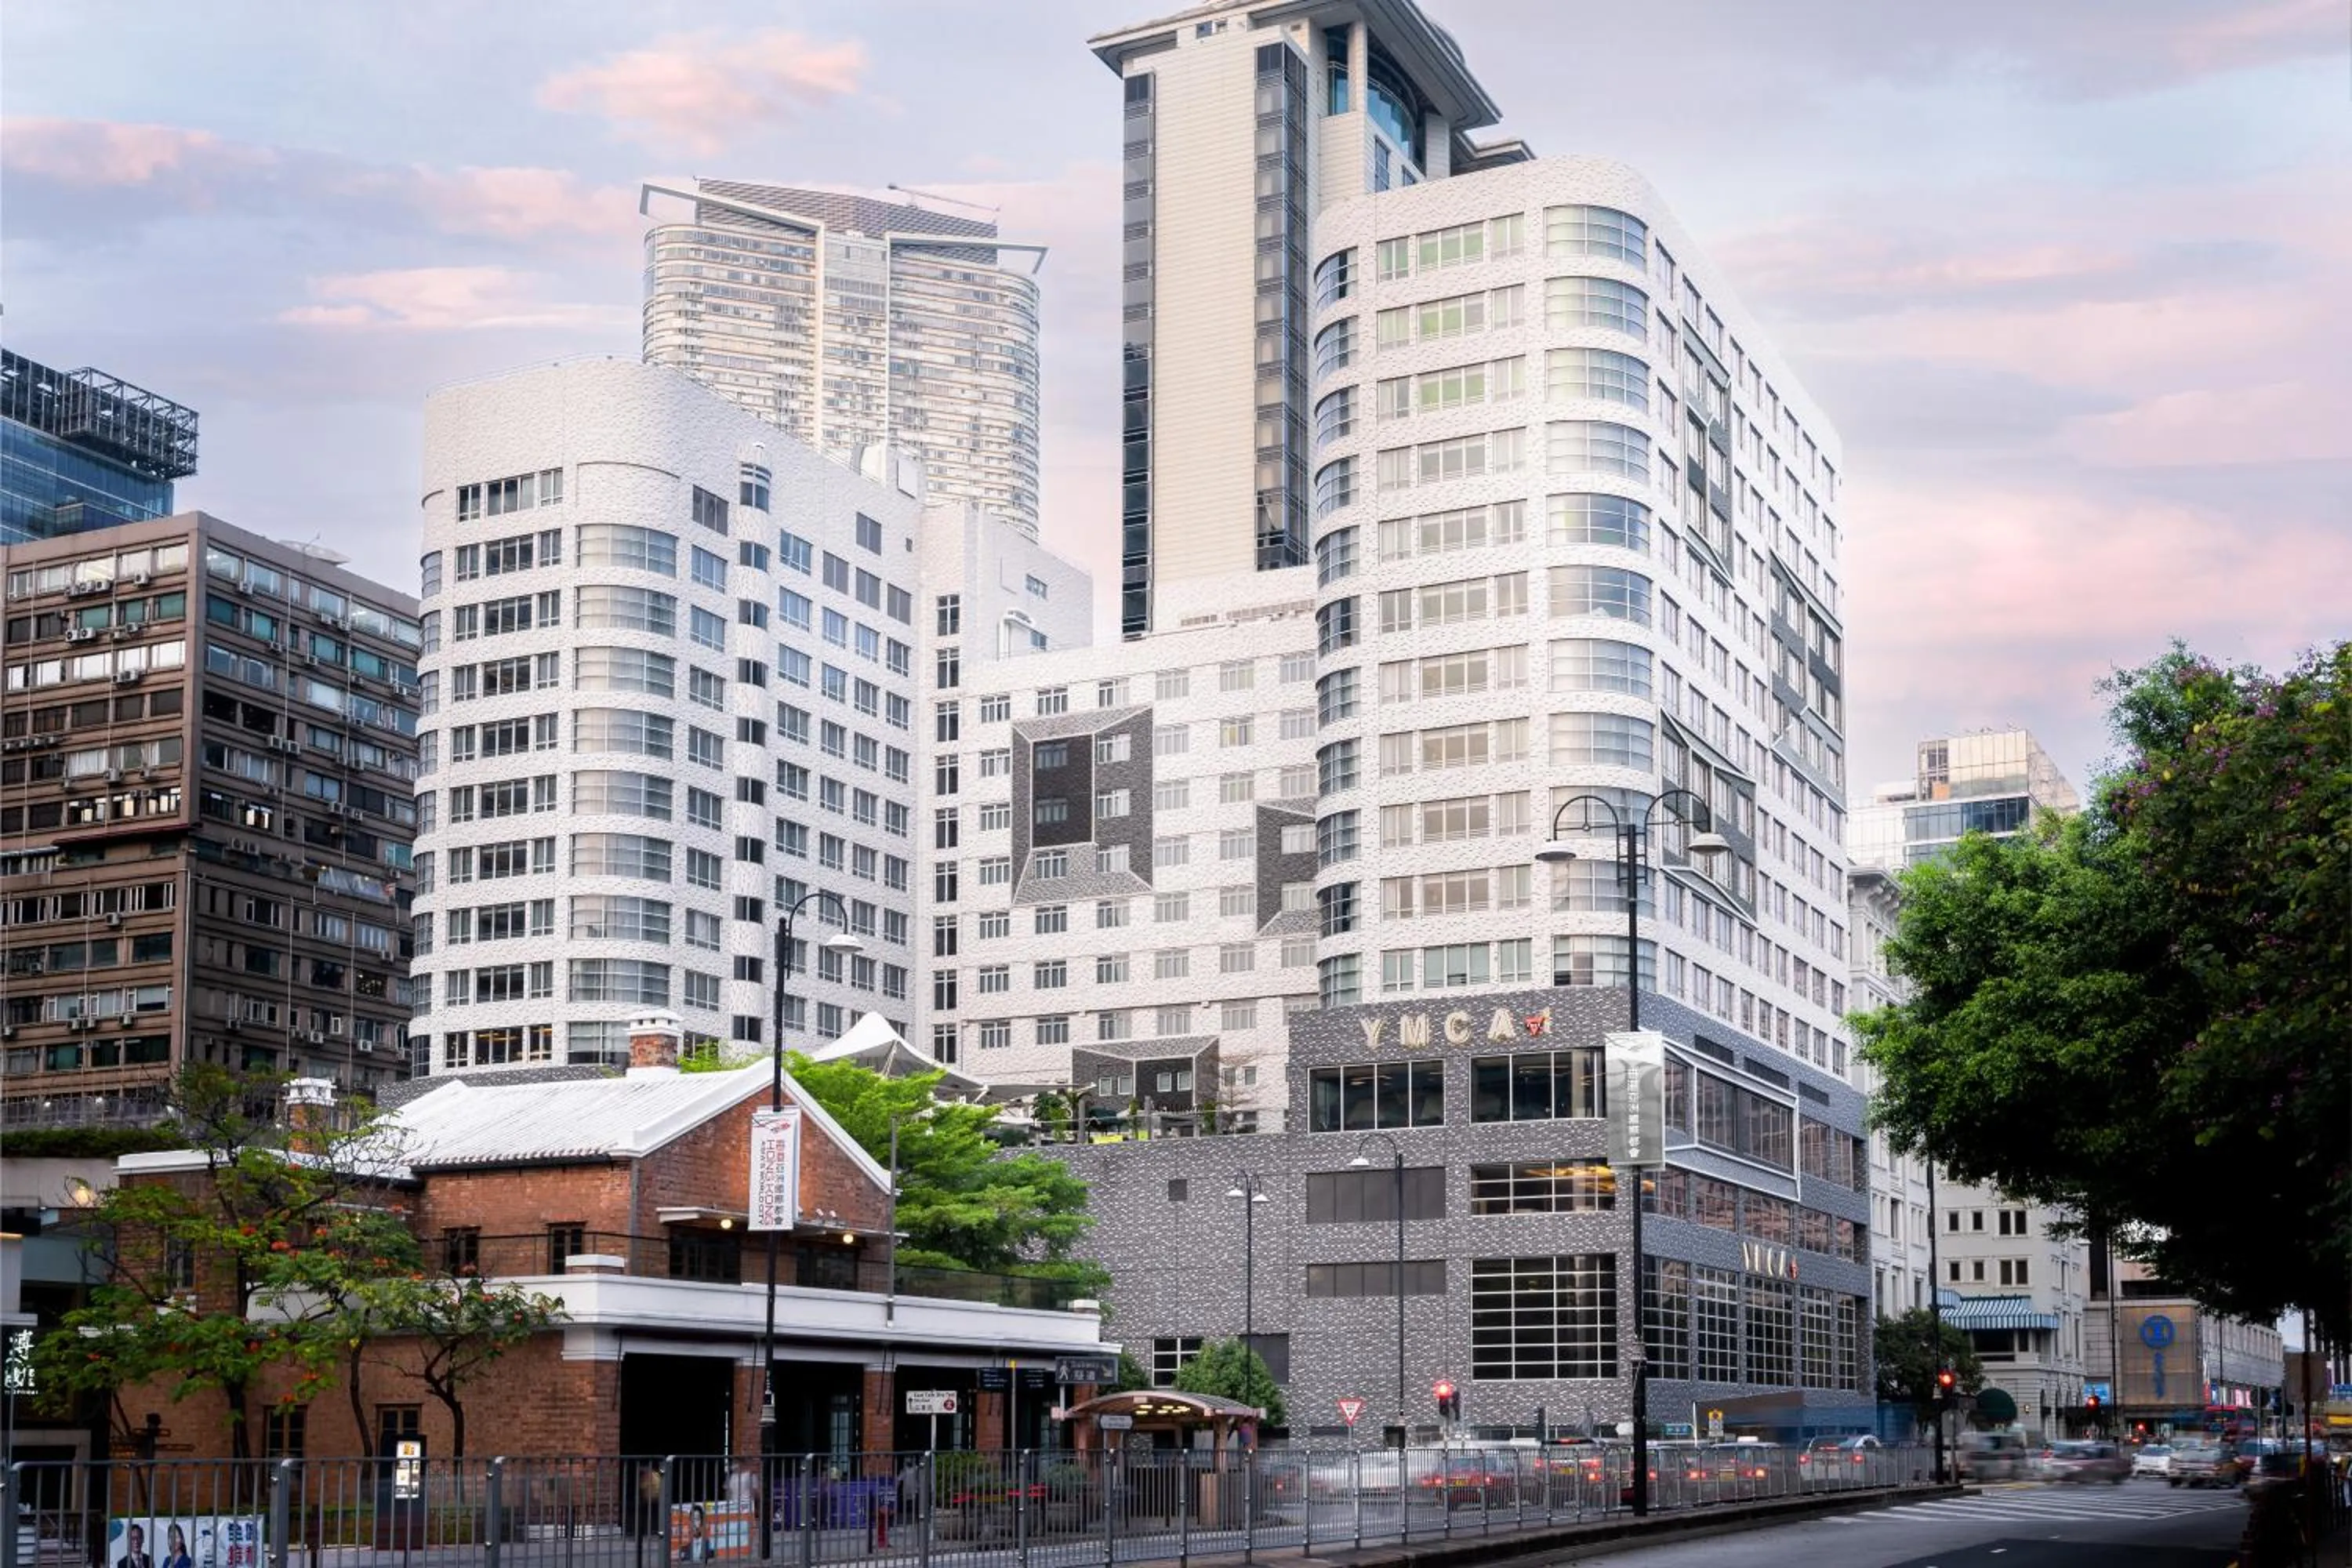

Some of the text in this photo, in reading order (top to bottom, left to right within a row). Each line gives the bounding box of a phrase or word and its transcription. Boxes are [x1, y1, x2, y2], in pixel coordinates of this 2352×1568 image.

[1359, 1007, 1516, 1049] YMCA
[764, 1139, 775, 1225] HONG KONG
